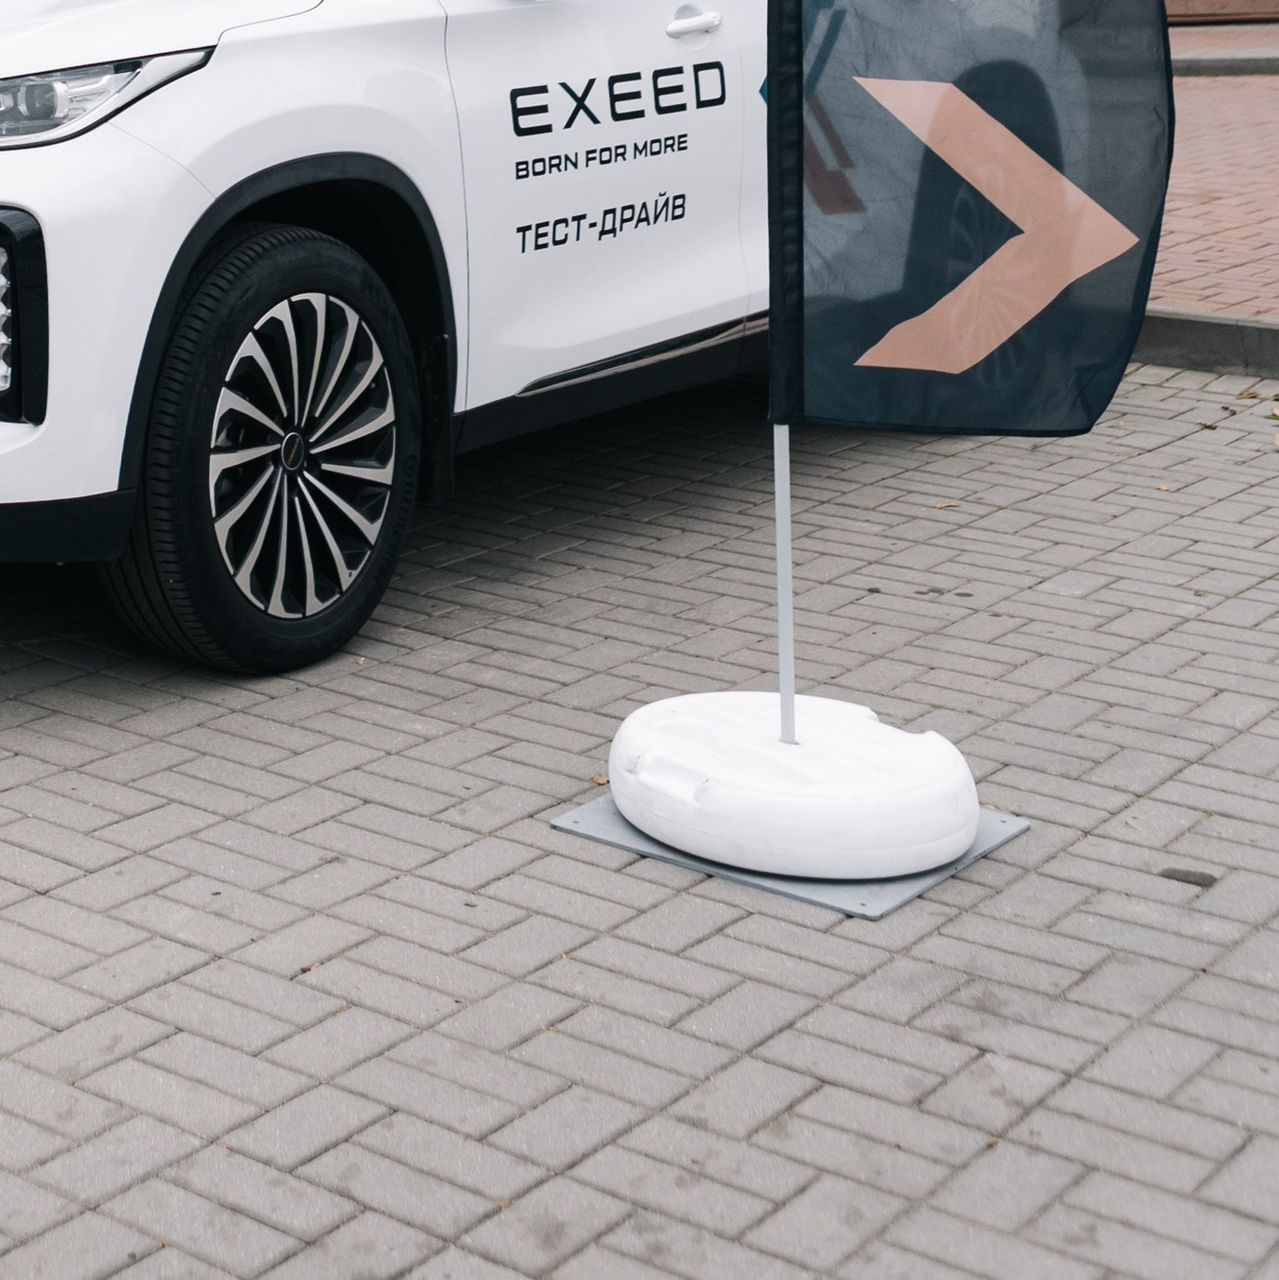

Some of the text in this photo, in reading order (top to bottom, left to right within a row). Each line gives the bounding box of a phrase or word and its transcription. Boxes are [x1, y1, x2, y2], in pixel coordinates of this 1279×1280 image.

[509, 61, 726, 137] EXEED
[515, 133, 689, 180] BORN FOR MORE
[516, 192, 687, 253] ТЕСТ-ДРАЙВ
